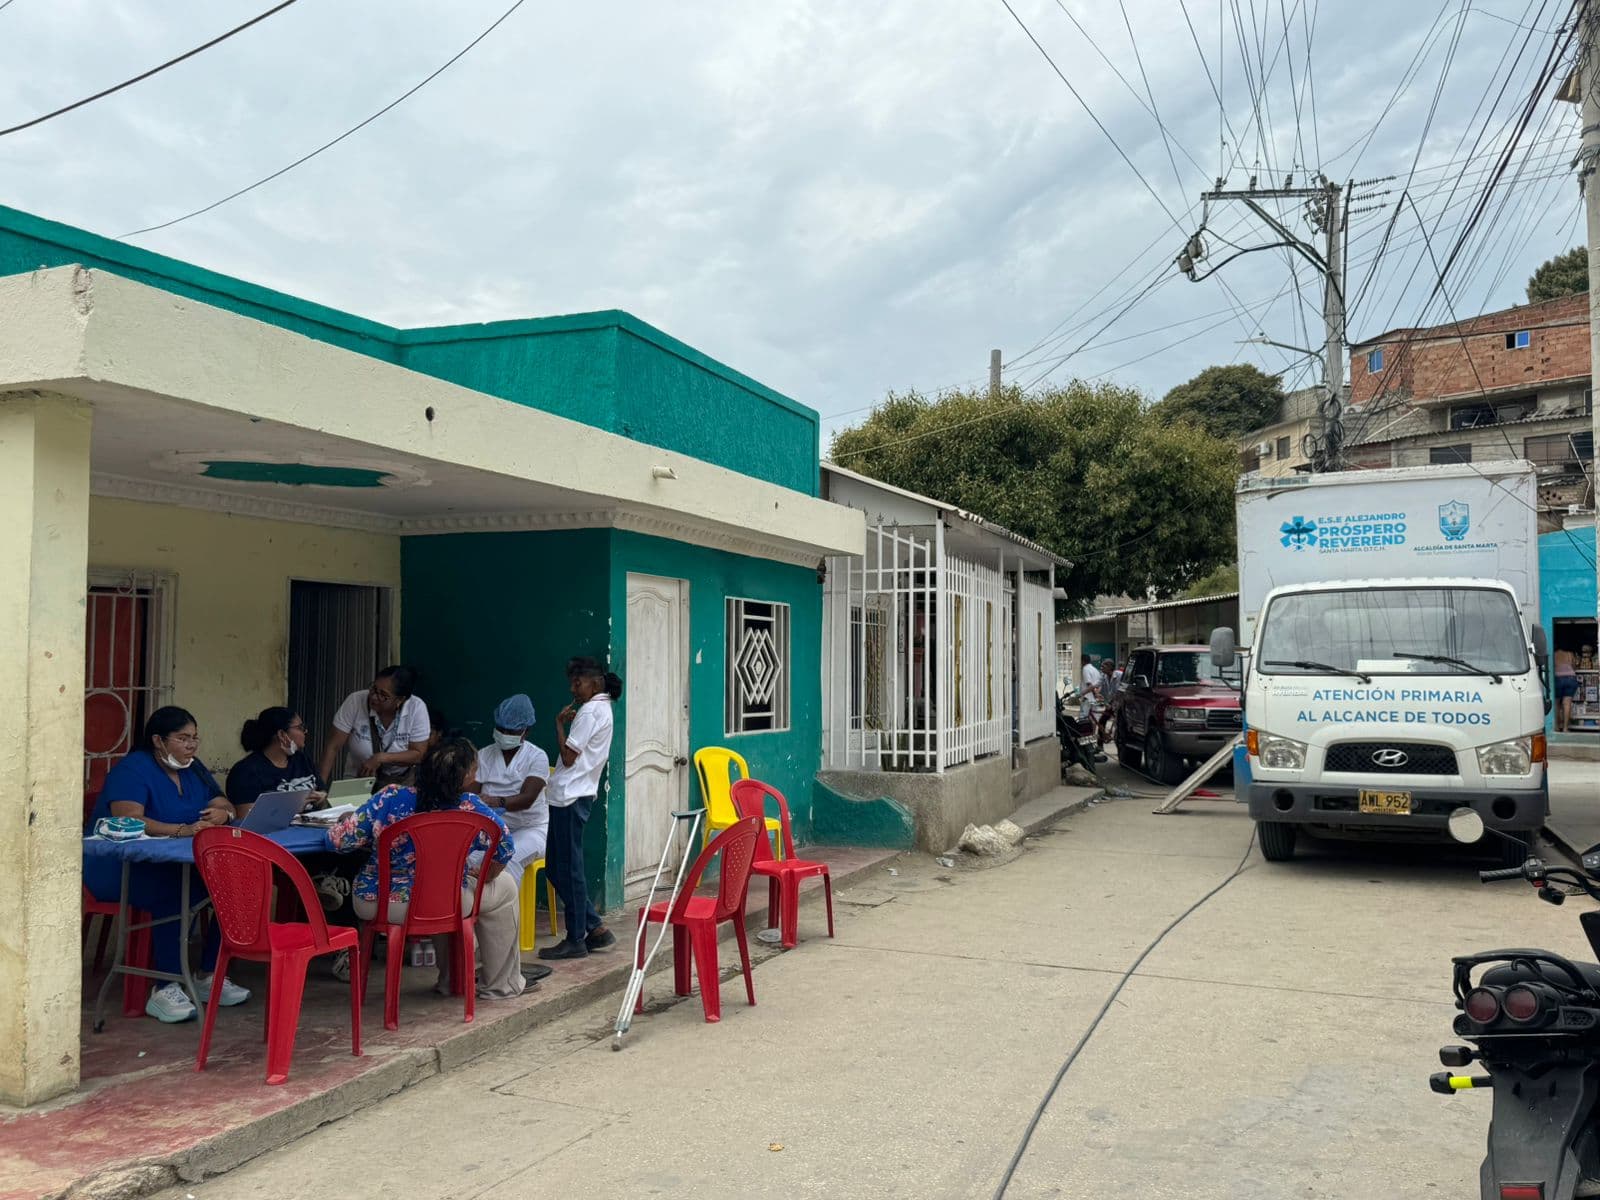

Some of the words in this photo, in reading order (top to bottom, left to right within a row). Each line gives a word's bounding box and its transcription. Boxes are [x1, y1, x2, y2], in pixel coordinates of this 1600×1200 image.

[1345, 512, 1406, 523] ALEJANDRO
[1319, 522, 1407, 537] PRÓSPERO
[1320, 535, 1406, 549] REVEREND
[1313, 687, 1395, 701] ATENCIÓN
[1401, 689, 1483, 703] PRIMARIA
[1297, 710, 1317, 722] AL
[1322, 710, 1399, 723] ALCANCE
[1405, 711, 1427, 723] DE
[1432, 712, 1491, 725] TODOS
[1386, 794, 1409, 809] 952
